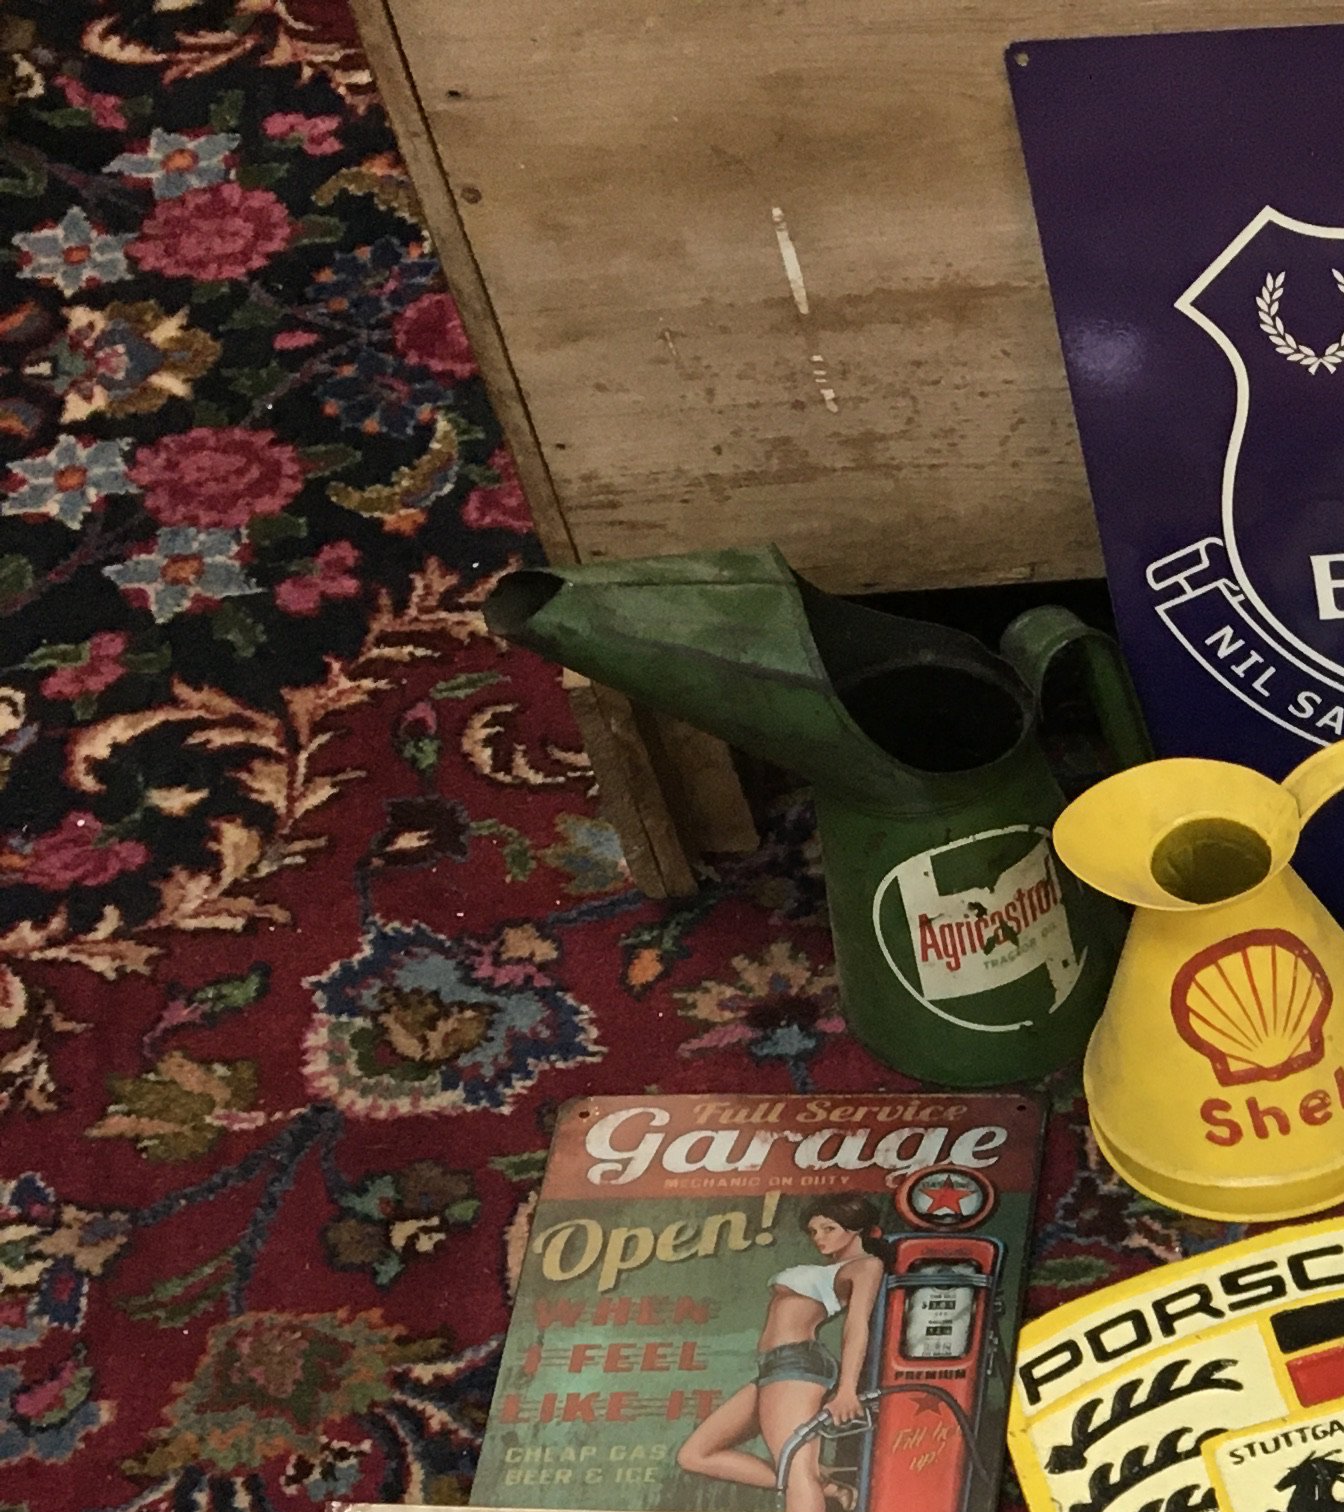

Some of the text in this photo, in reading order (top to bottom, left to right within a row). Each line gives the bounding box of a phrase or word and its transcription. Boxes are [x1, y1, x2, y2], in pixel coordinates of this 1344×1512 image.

[1204, 624, 1276, 698] NIL
[692, 1098, 969, 1126] Full Service
[584, 1106, 1009, 1189] Garage
[663, 1174, 851, 1190] MECHANIC ON DUTY
[533, 1191, 782, 1294] Open!
[567, 1341, 709, 1374] FEEL
[893, 1369, 967, 1382] PREMIUM
[499, 1388, 723, 1425] LIKE IT
[504, 1443, 668, 1464] CHEAP GAS
[504, 1468, 573, 1486] BEER
[615, 1467, 659, 1484] ICE
